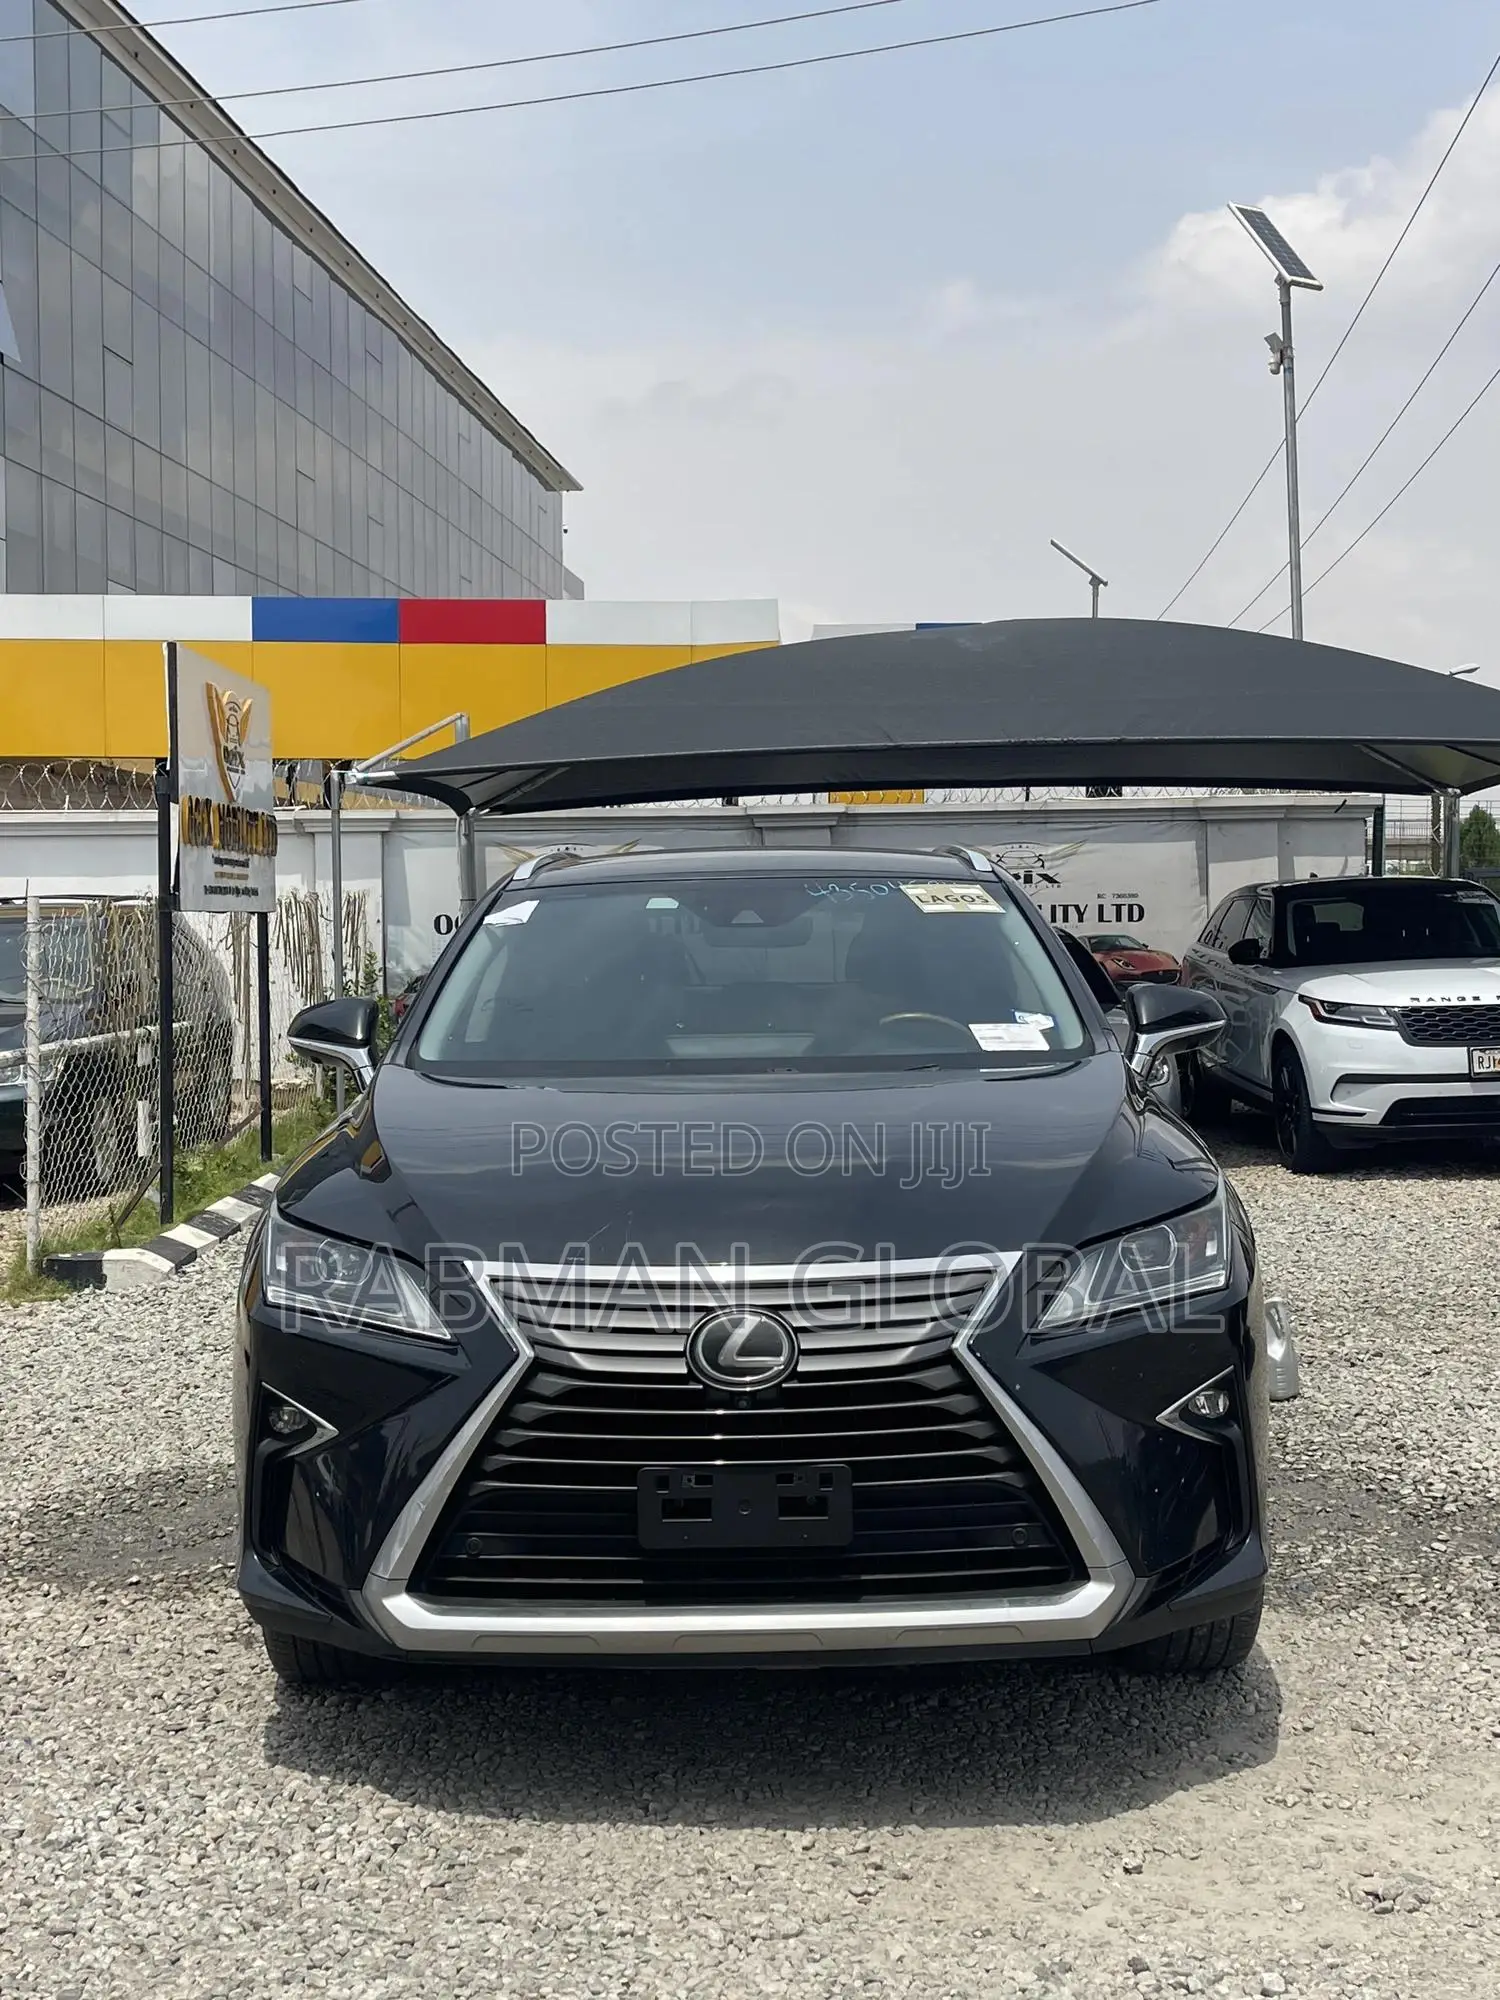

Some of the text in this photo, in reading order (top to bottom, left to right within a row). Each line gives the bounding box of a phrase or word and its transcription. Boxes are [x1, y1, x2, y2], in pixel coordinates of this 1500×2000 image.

[915, 894, 990, 904] LAGOS
[1036, 903, 1145, 924] ITY LTD
